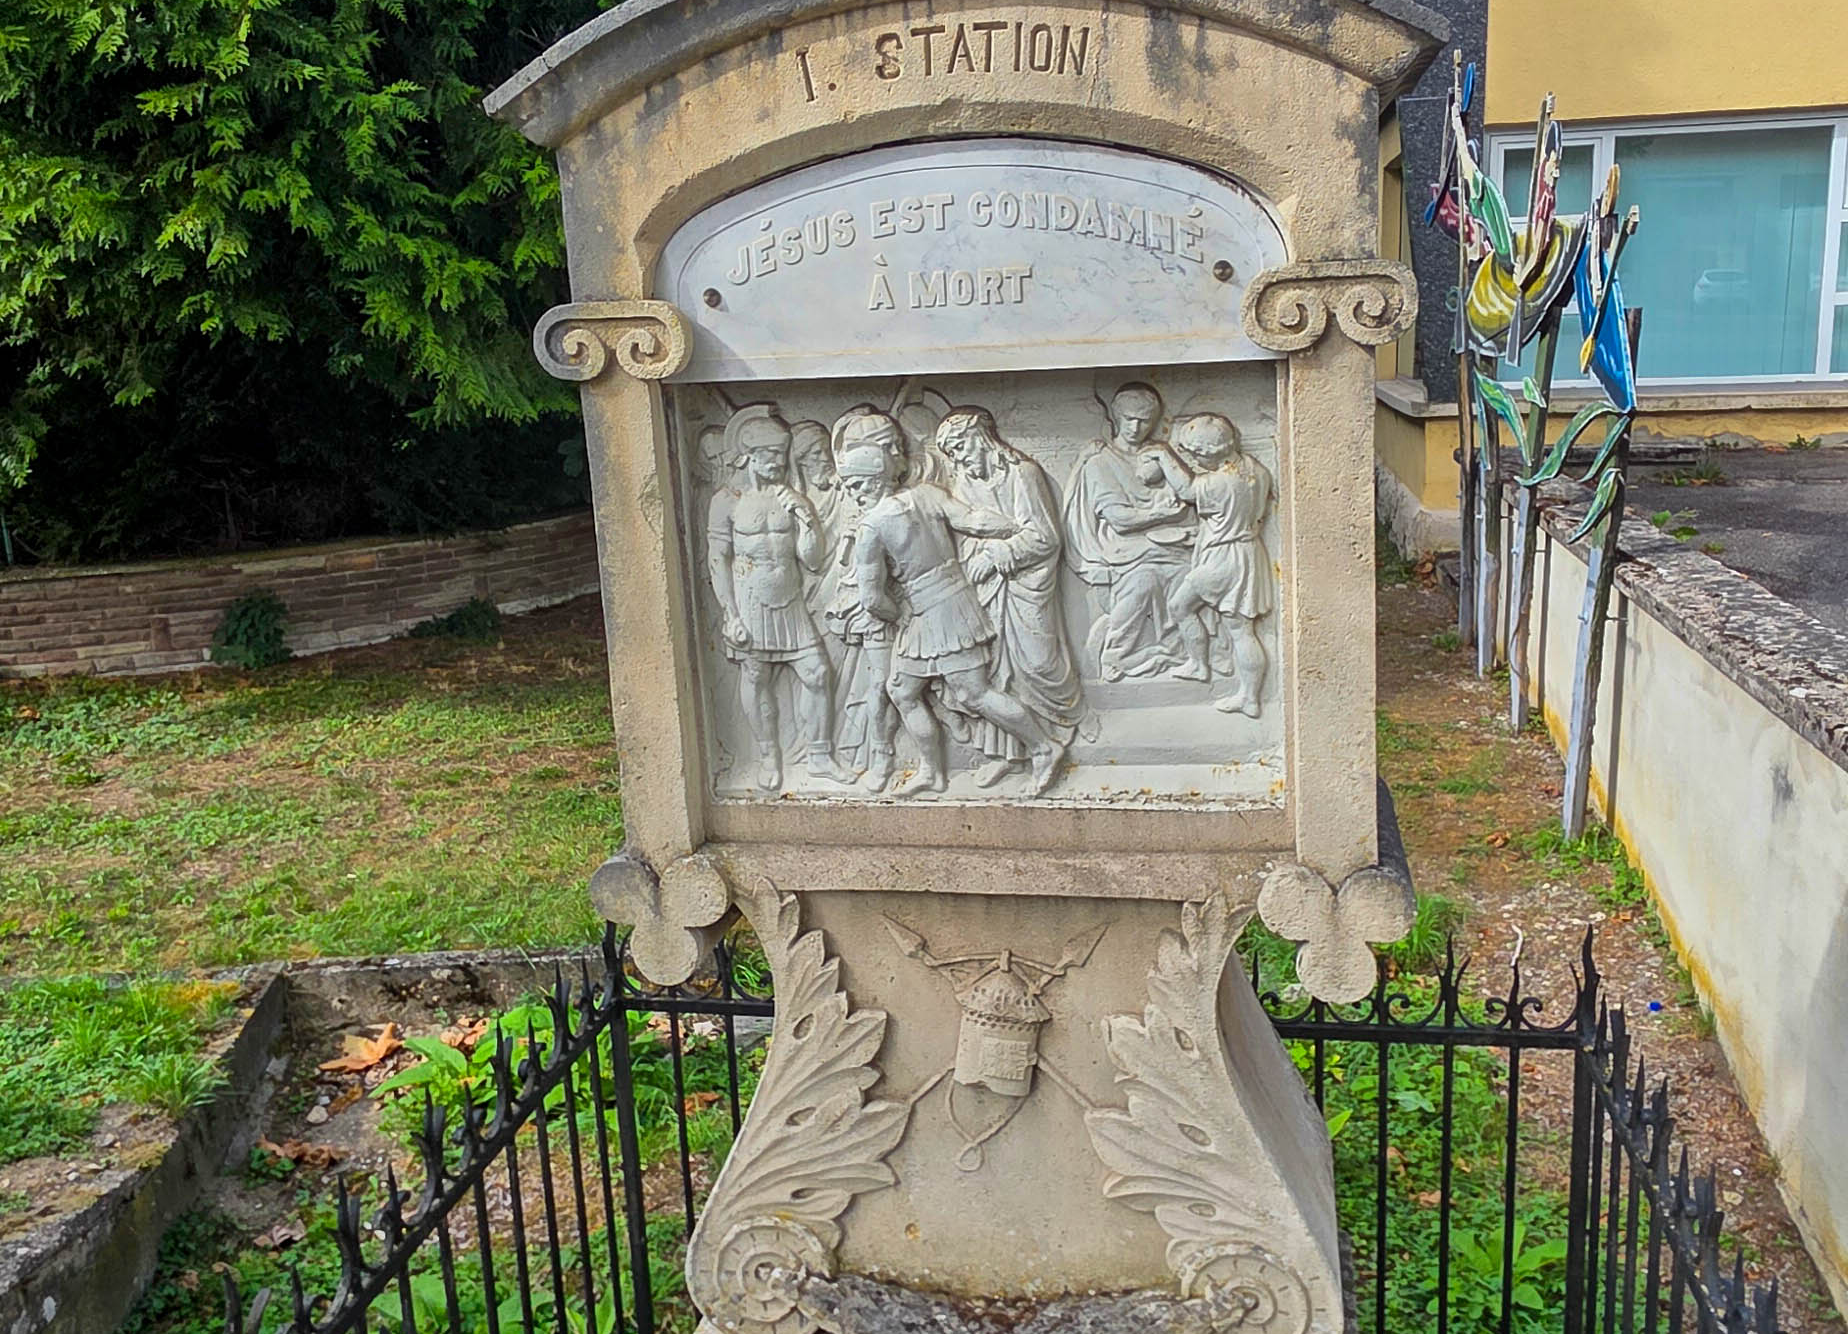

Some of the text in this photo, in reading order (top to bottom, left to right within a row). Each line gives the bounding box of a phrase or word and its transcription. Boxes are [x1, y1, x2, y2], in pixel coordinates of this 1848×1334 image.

[794, 20, 1092, 103] I. STATION
[728, 193, 1204, 285] JÉSUS EST CONDAMNÉ
[867, 254, 1033, 310] À MORT
